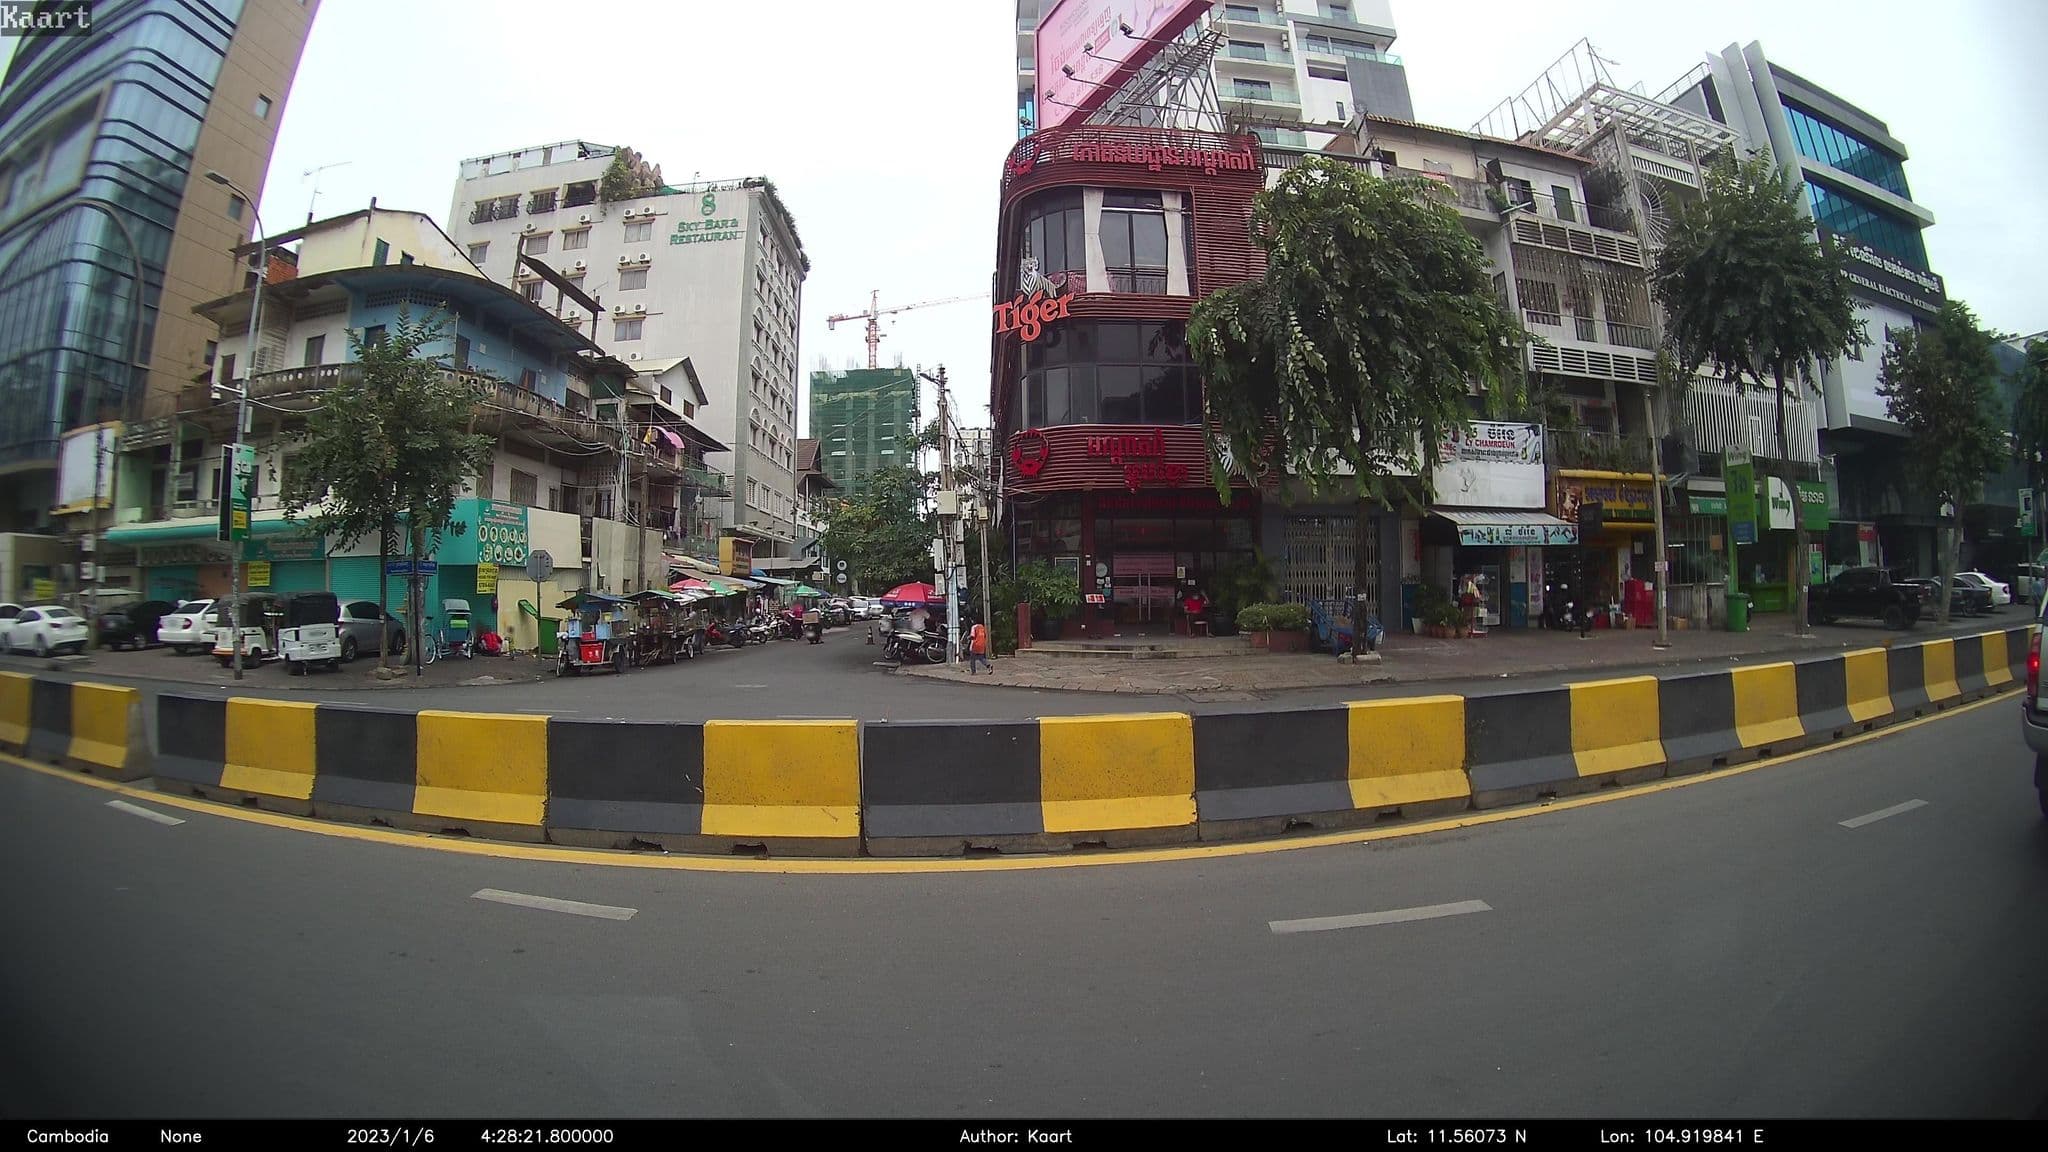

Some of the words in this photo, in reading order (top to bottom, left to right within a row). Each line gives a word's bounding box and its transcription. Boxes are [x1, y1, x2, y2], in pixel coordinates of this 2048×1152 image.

[701, 193, 716, 216] 8
[1848, 272, 1879, 291] GENERAL
[992, 289, 1075, 342] Tiger
[1771, 494, 1791, 518] Wing
